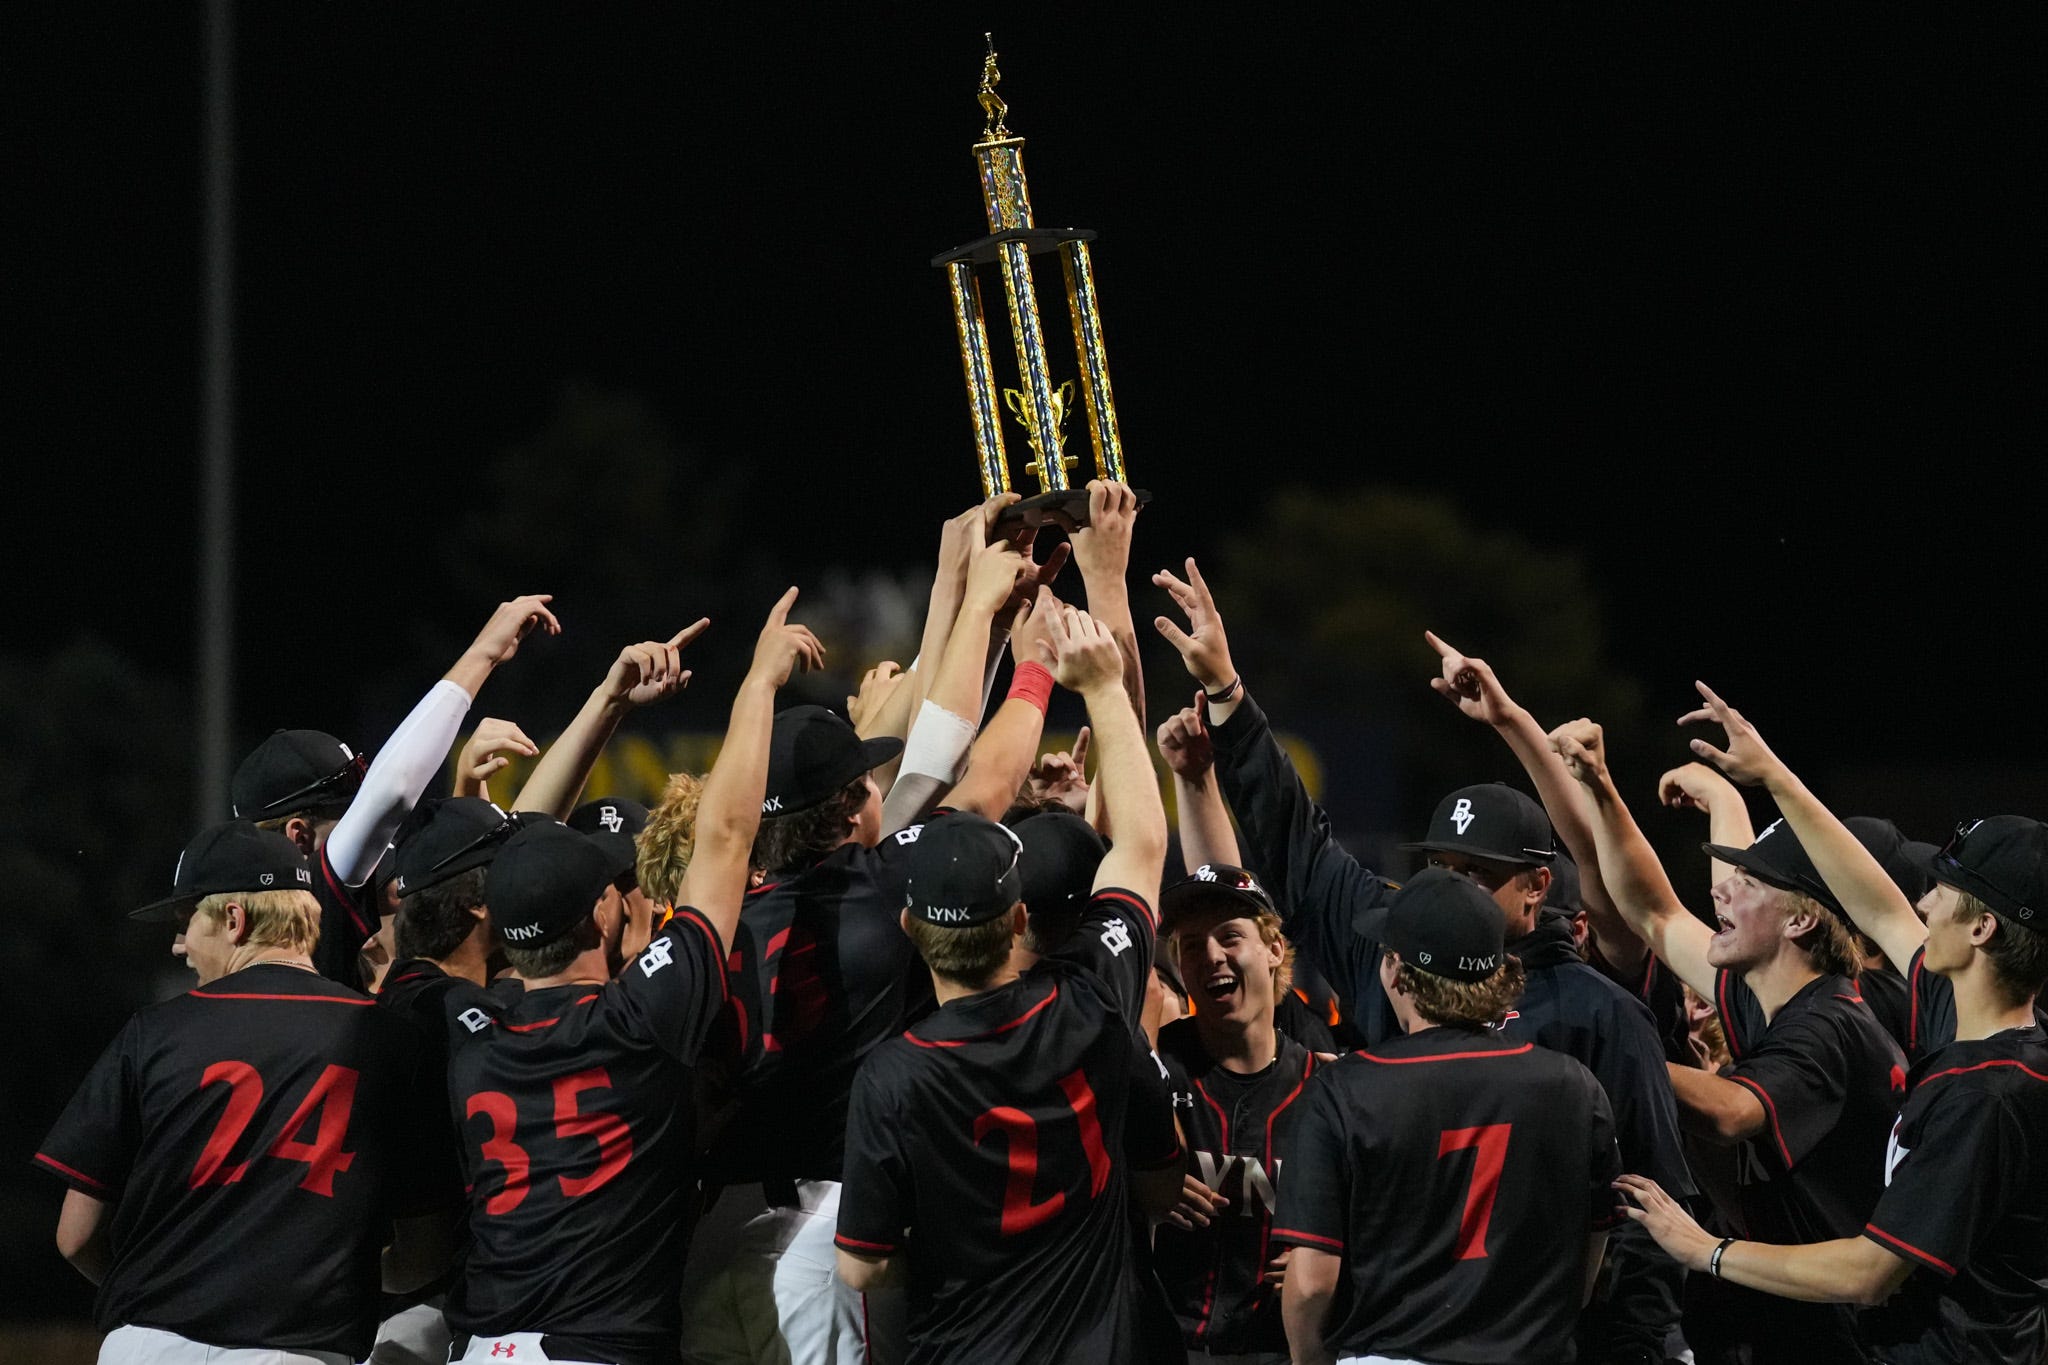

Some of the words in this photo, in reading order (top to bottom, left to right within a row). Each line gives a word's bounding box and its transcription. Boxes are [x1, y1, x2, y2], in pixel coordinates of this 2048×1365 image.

[600, 805, 624, 833] BV
[763, 795, 784, 813] NX
[1449, 798, 1476, 835] BV
[295, 866, 312, 884] LYN
[927, 905, 971, 923] LYNX
[504, 921, 544, 942] LYNX
[1458, 953, 1497, 973] LYNX
[190, 1060, 360, 1198] 24
[466, 1066, 633, 1216] 35
[973, 1067, 1112, 1236] 21
[1195, 1151, 1284, 1218] YN
[1437, 1123, 1512, 1261] 7
